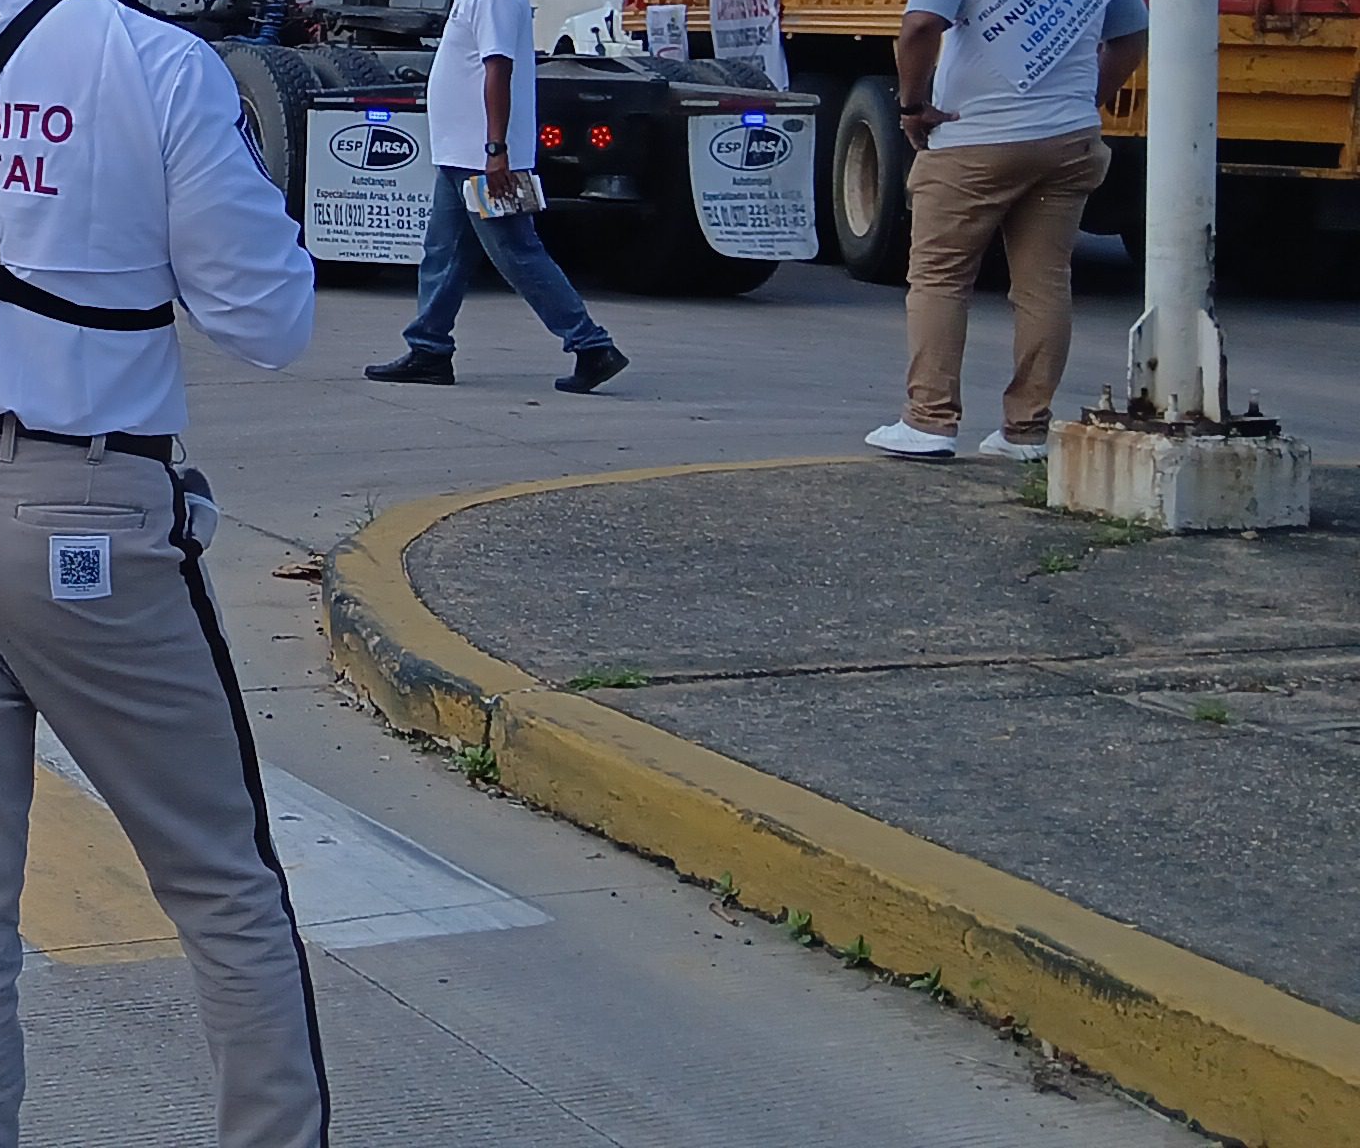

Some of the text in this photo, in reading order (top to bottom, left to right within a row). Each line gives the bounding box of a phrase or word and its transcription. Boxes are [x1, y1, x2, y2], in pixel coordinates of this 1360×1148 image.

[982, 21, 1005, 43] EN
[1020, 6, 1067, 53] LIBROS
[1052, 38, 1070, 56] CON
[1068, 26, 1080, 39] UN
[1023, 60, 1036, 71] AL
[1035, 26, 1068, 60] VOLANTE
[1065, 16, 1077, 27] VA
[337, 140, 410, 154] ESP ARSA
[717, 140, 784, 153] ESP ARSA
